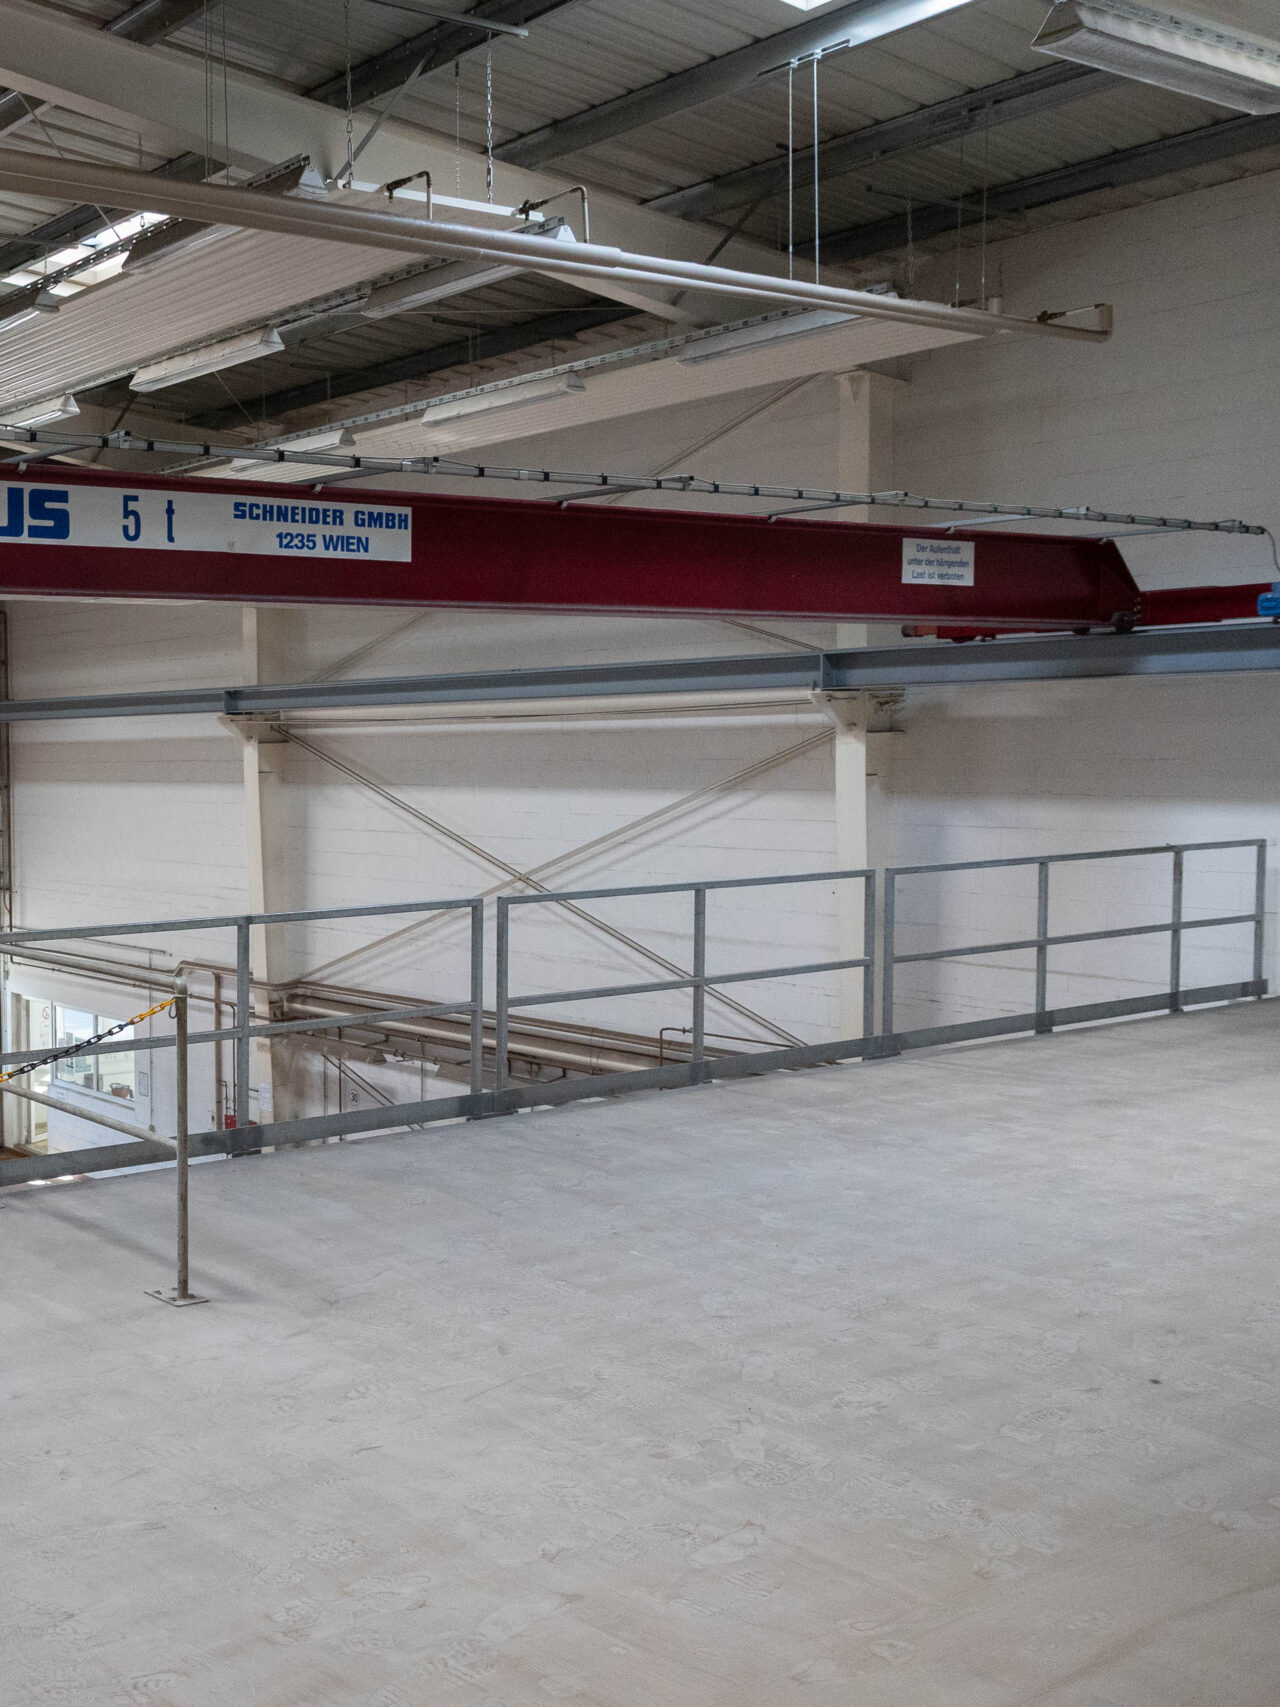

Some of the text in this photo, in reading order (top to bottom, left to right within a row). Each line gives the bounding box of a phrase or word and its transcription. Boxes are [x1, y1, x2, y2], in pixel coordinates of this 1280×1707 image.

[122, 494, 141, 542] 5
[165, 499, 175, 543] t
[233, 501, 409, 530] SCHNEIDER GMBH
[276, 531, 369, 553] 1235 WIEN
[916, 543, 928, 552] Der
